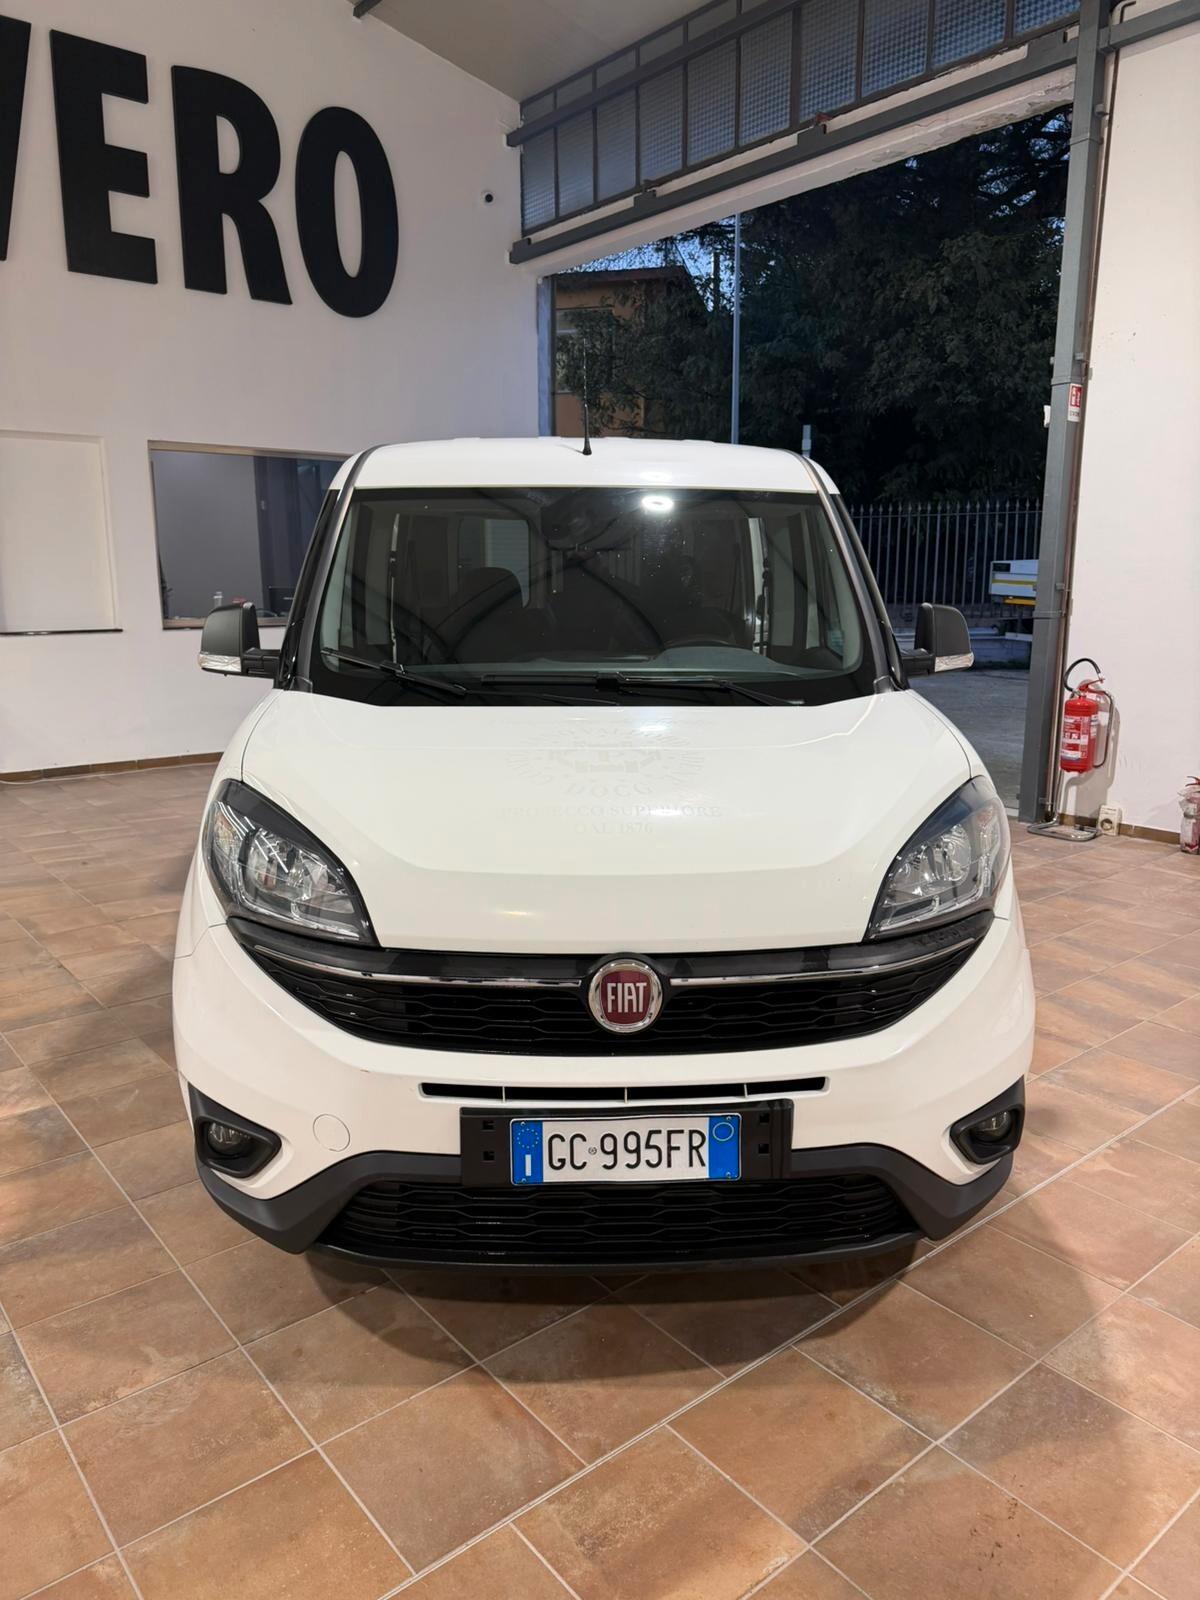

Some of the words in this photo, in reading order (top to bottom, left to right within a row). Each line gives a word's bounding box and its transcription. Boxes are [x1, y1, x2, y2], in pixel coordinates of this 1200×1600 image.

[501, 807, 604, 817] PROECCO
[608, 806, 722, 817] SUPORE
[607, 982, 647, 1013] FIAT
[548, 1133, 587, 1171] GC
[600, 1129, 707, 1170] 995FR
